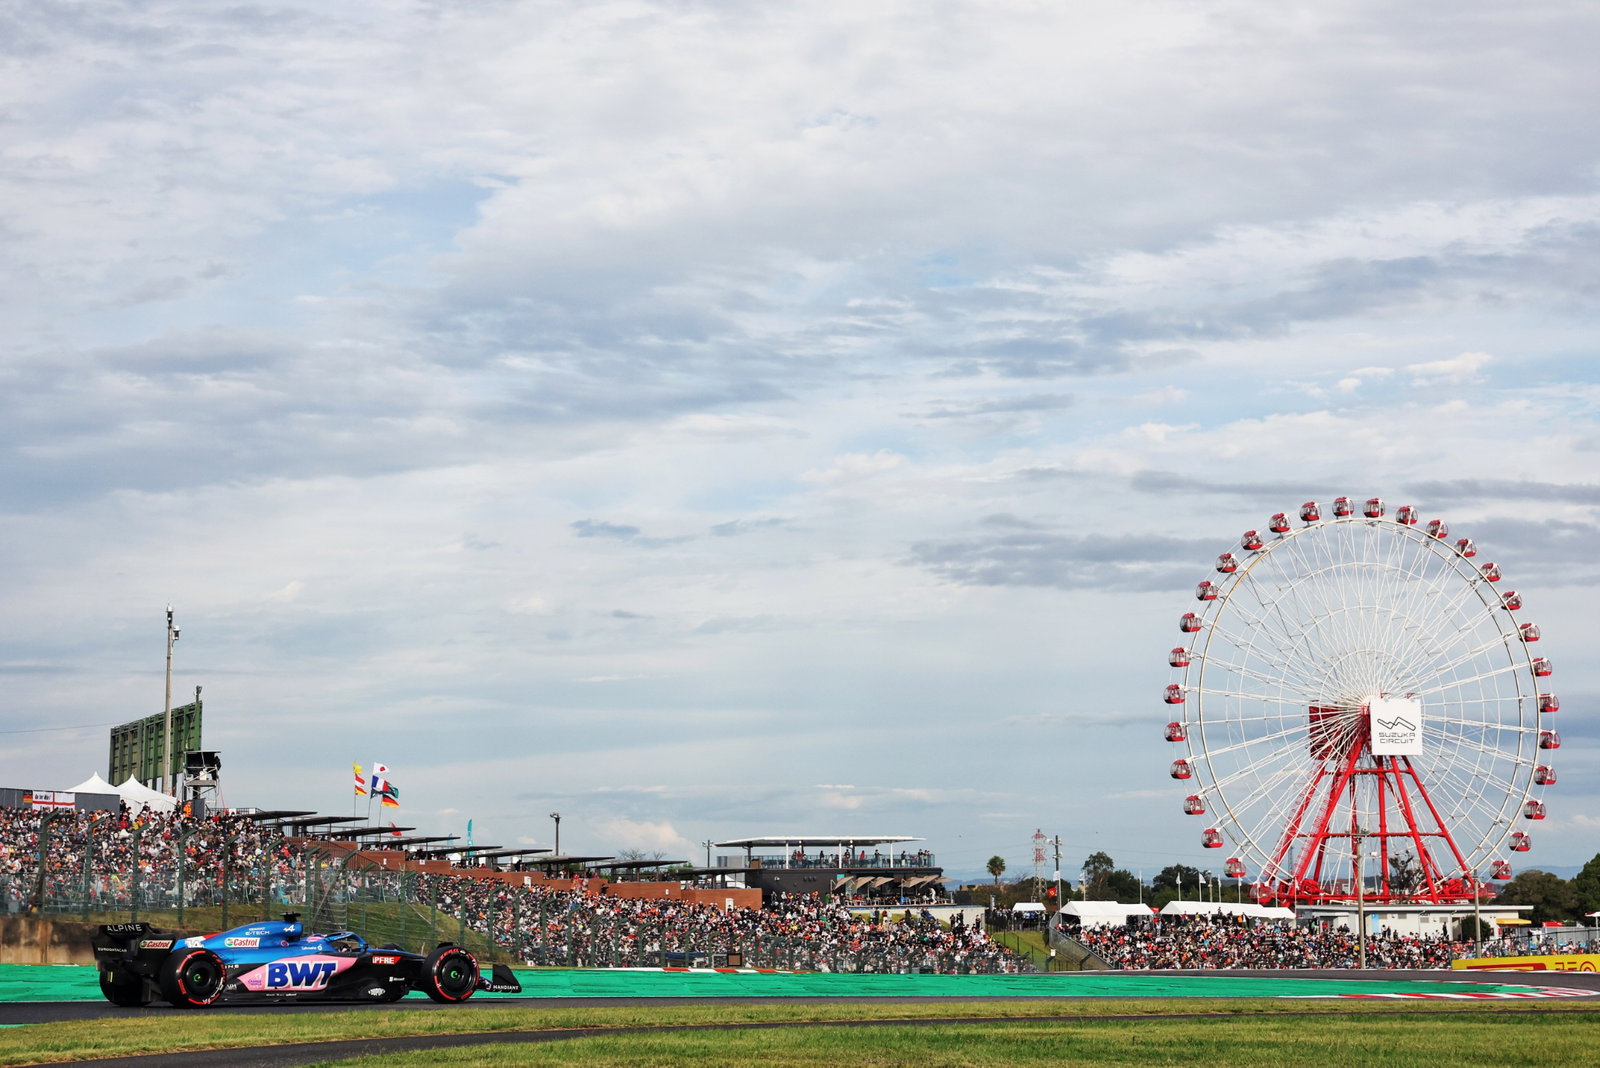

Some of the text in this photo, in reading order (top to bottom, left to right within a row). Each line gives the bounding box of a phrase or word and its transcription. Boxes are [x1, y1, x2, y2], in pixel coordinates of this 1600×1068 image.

[107, 924, 143, 932] ALPINE
[233, 939, 258, 947] Castrol
[267, 961, 338, 988] BWT
